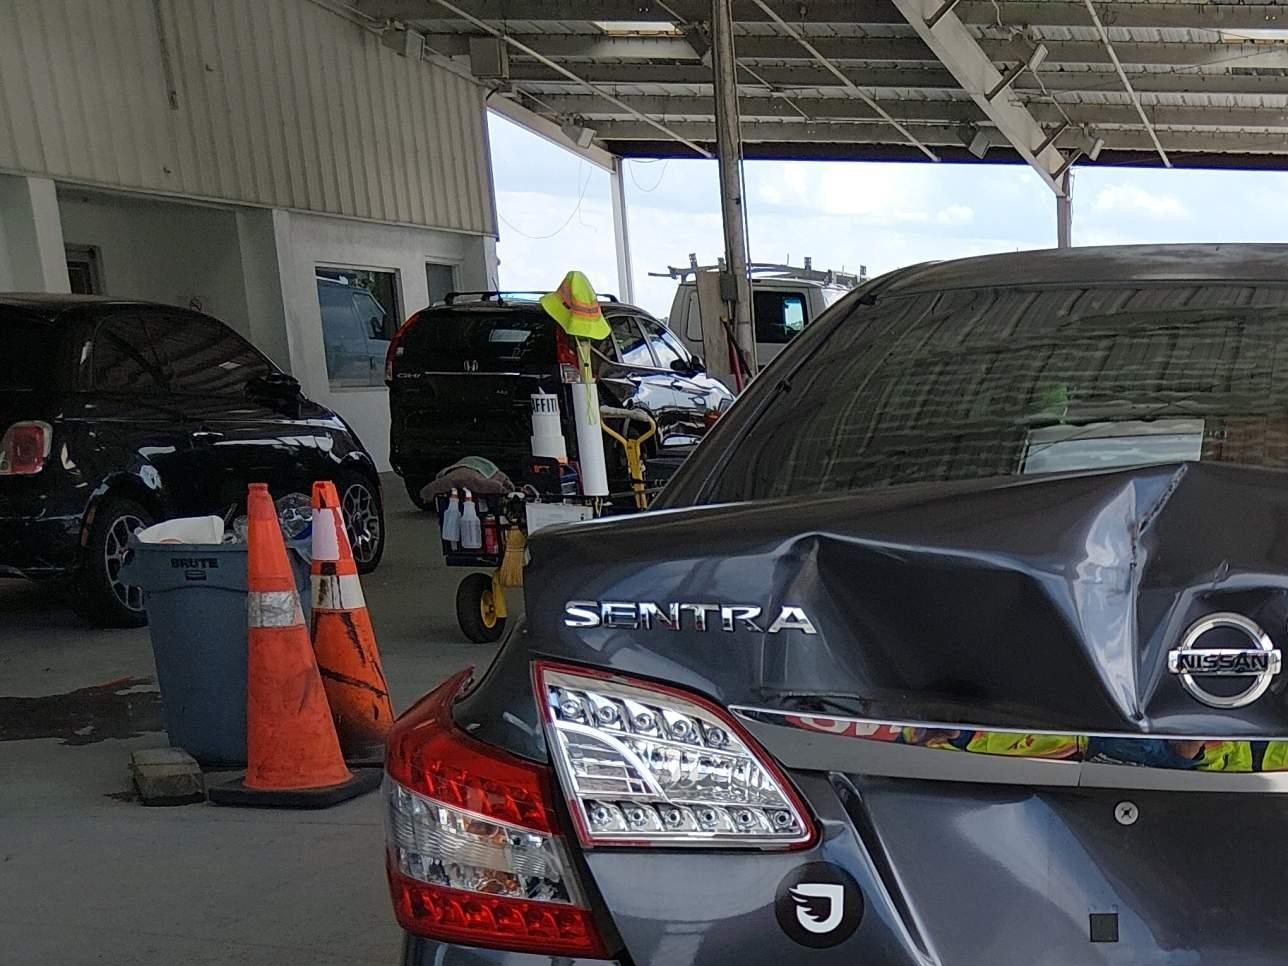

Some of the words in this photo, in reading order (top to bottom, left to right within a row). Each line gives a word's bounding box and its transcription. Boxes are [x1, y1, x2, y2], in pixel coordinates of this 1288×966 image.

[170, 558, 218, 568] BRUTE
[564, 600, 817, 634] SENTRA
[1176, 652, 1268, 672] NISSAN
